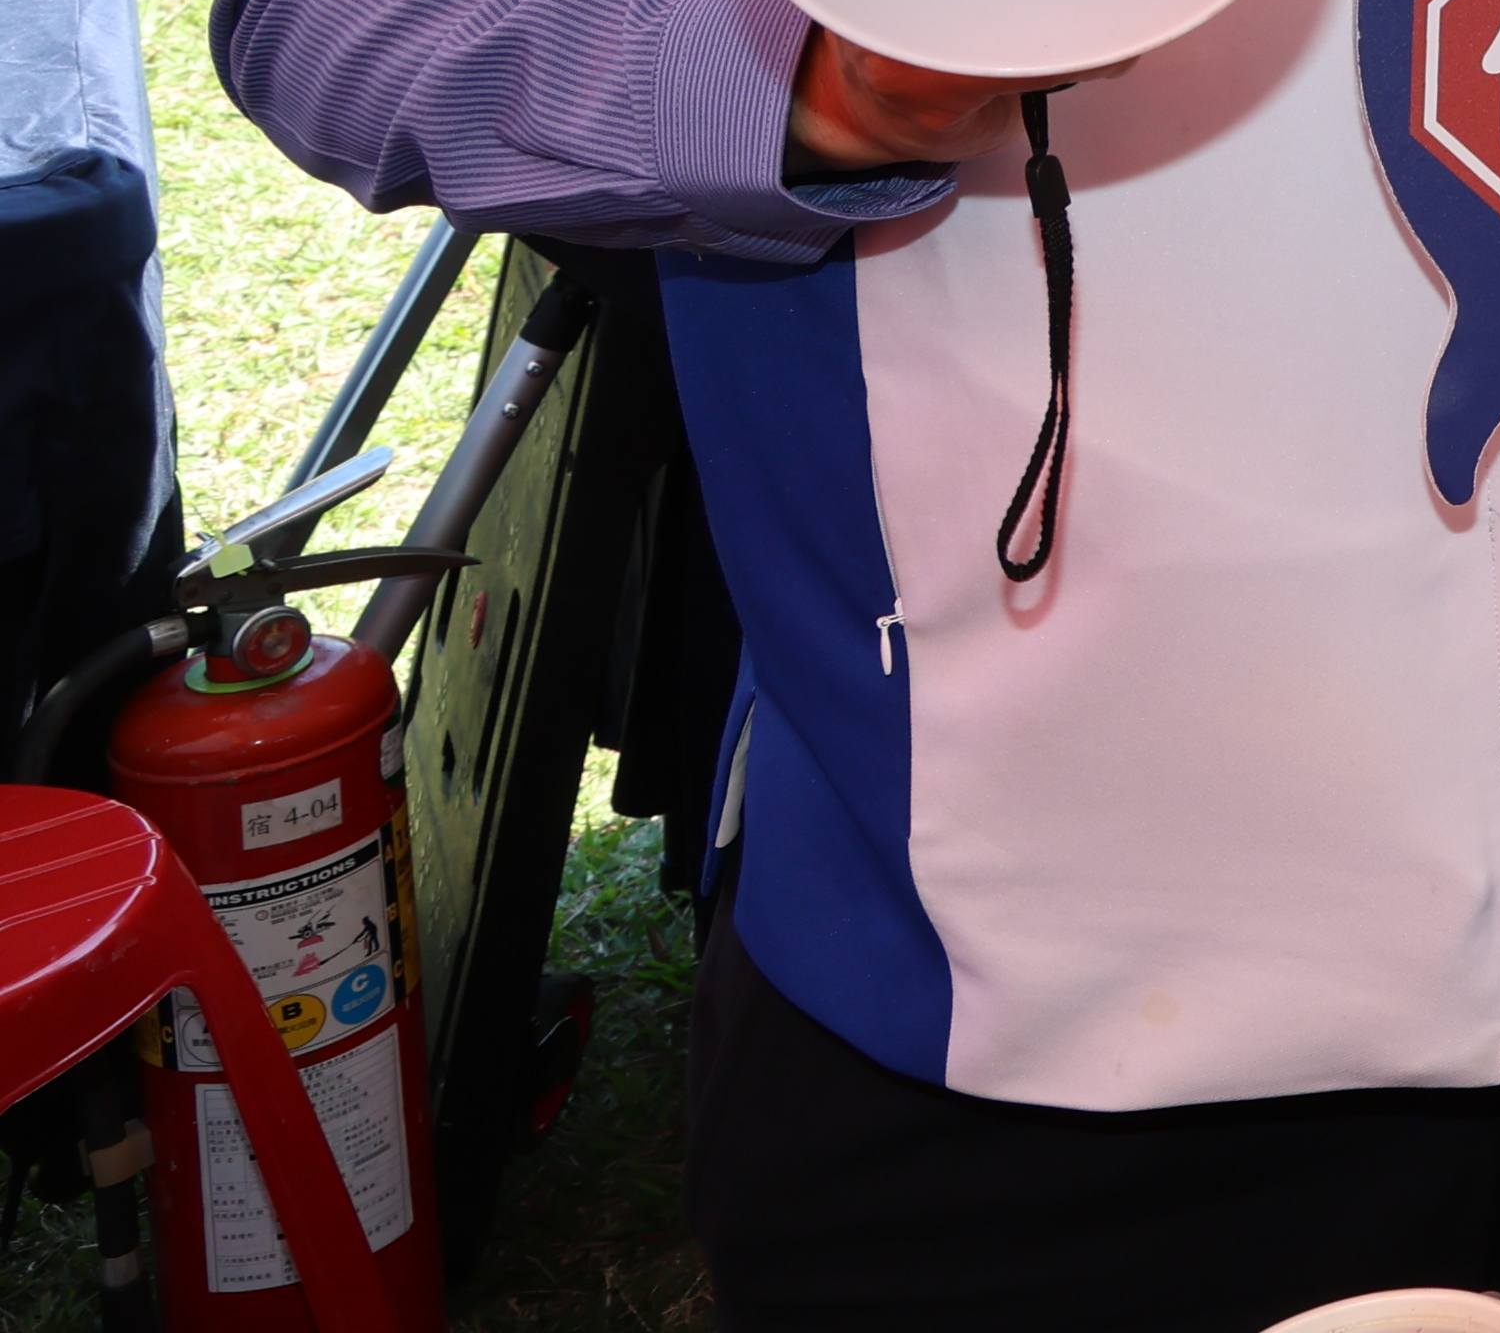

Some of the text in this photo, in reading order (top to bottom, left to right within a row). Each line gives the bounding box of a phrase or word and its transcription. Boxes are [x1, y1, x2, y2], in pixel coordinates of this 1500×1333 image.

[283, 792, 339, 826] 4-04
[208, 857, 357, 907] INSTRUCTIONS
[281, 973, 369, 1021] B C
